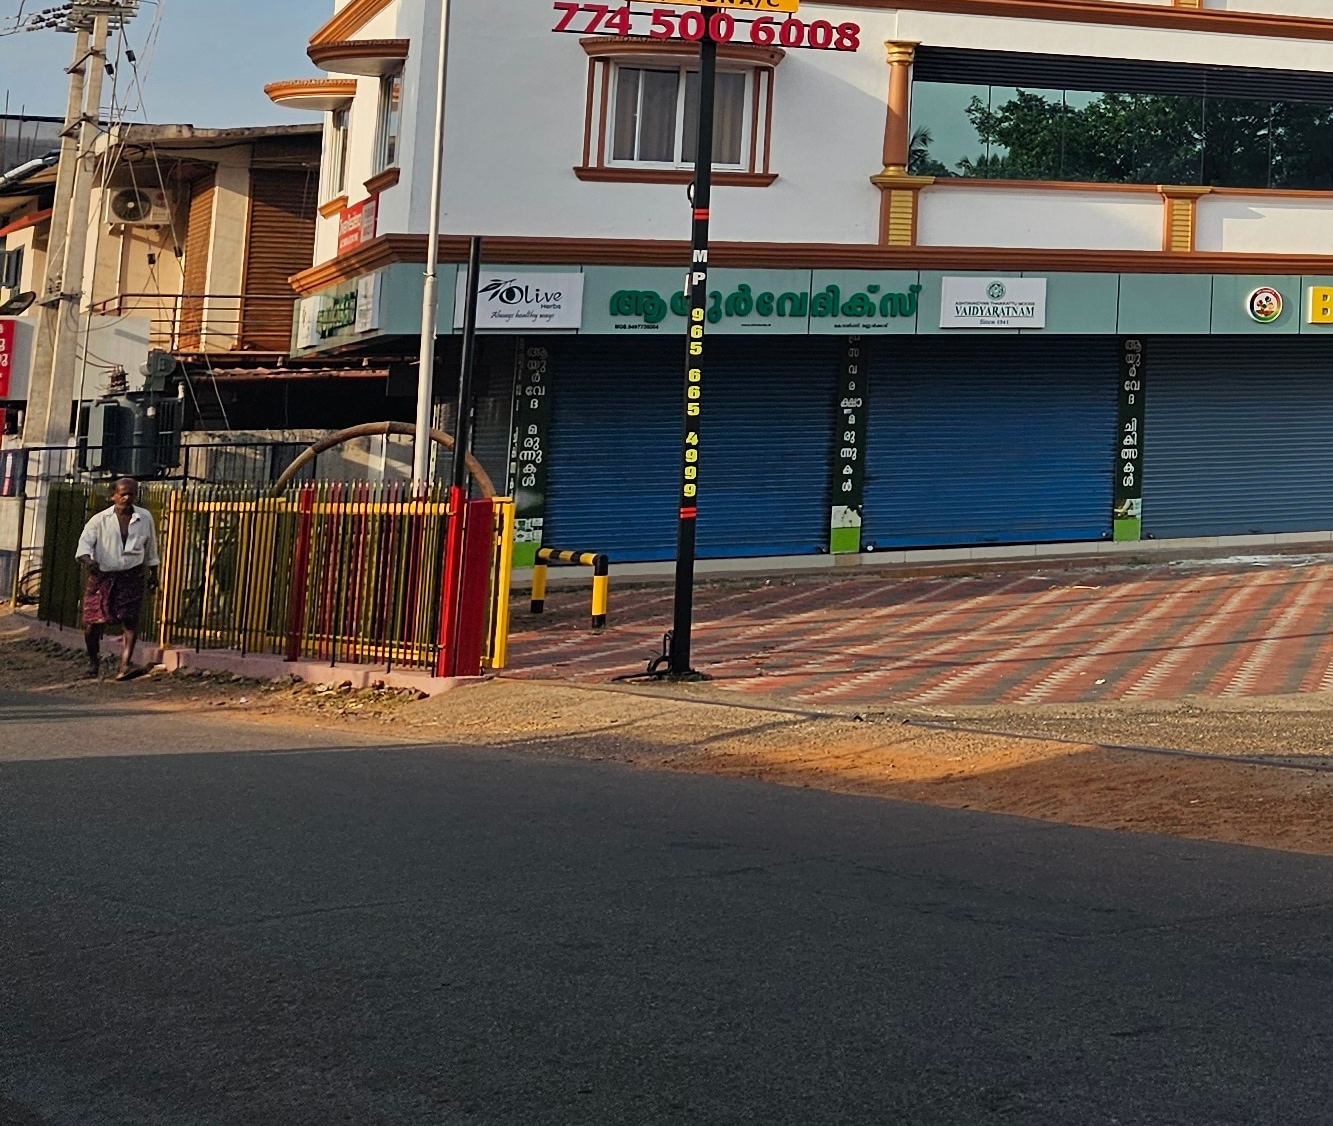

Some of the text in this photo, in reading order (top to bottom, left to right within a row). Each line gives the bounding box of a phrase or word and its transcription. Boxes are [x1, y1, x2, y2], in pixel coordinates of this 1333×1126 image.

[552, 1, 862, 52] 774 500 6008
[498, 284, 563, 305] Olive
[954, 305, 1035, 318] VAIDYARATNAM
